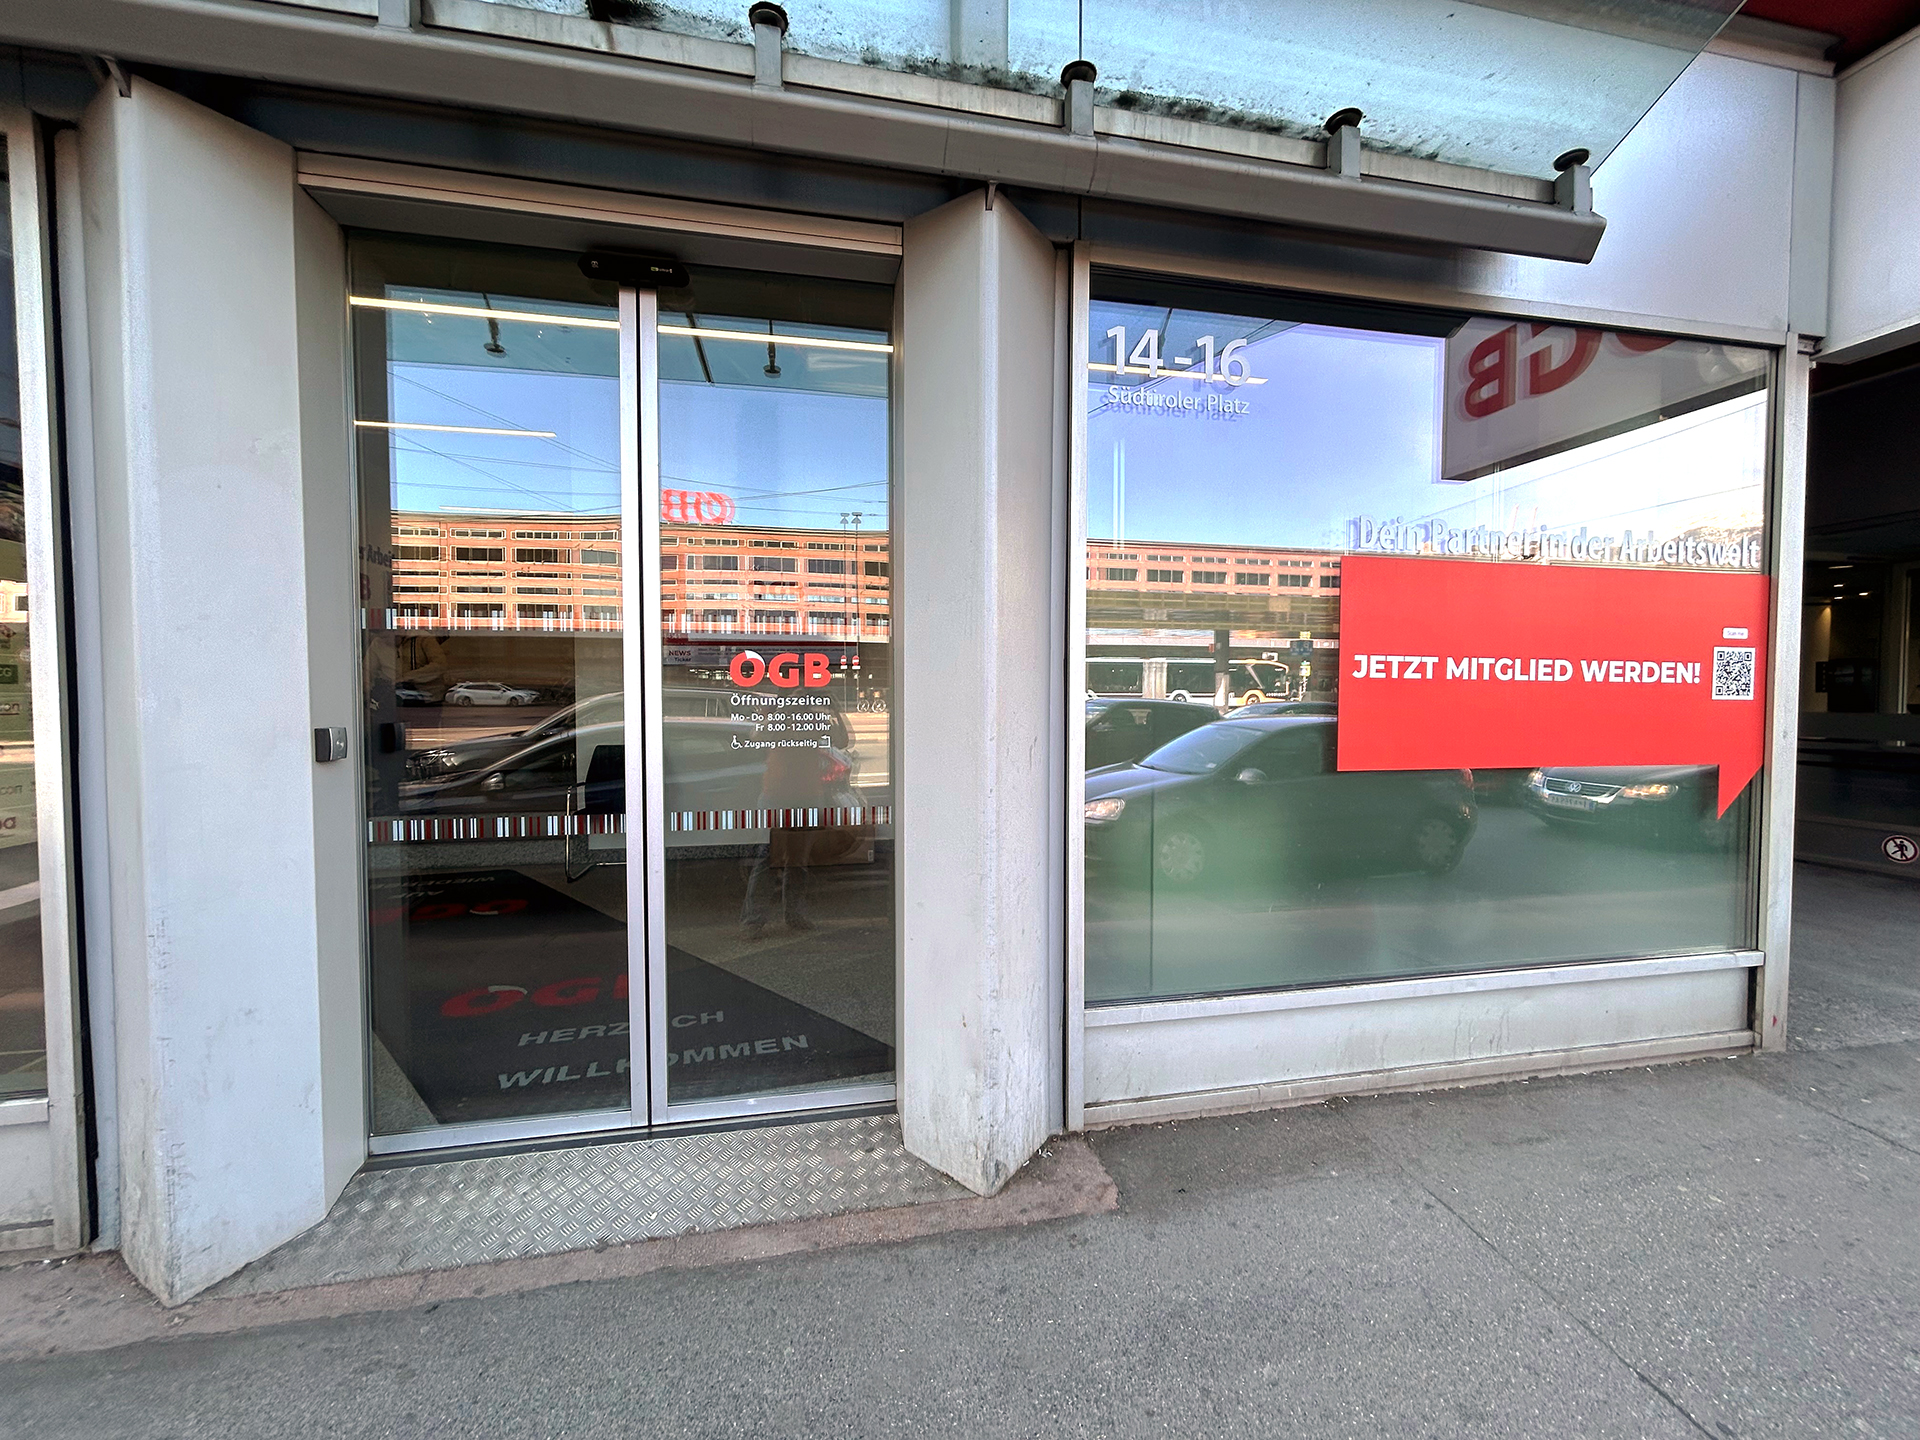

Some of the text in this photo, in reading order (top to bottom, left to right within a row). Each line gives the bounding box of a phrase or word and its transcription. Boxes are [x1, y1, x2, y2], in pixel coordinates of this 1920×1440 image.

[1108, 385, 1250, 414] Südtiroler Platz
[1360, 515, 1760, 568] Dein Partner in der Arbeitswelt
[1352, 654, 1701, 684] JETZT MITGLIED WERDEN!
[730, 693, 831, 708] Öffnungszeiten
[730, 713, 745, 721] Mo
[751, 713, 764, 721] Do
[767, 712, 786, 721] 8.00
[815, 712, 831, 721] Uhr
[755, 723, 764, 731] Fr
[767, 723, 786, 731] 8.00
[815, 723, 831, 731] Uhr
[744, 739, 818, 749] Zugang rückseitig
[518, 1010, 724, 1046] HERZCH
